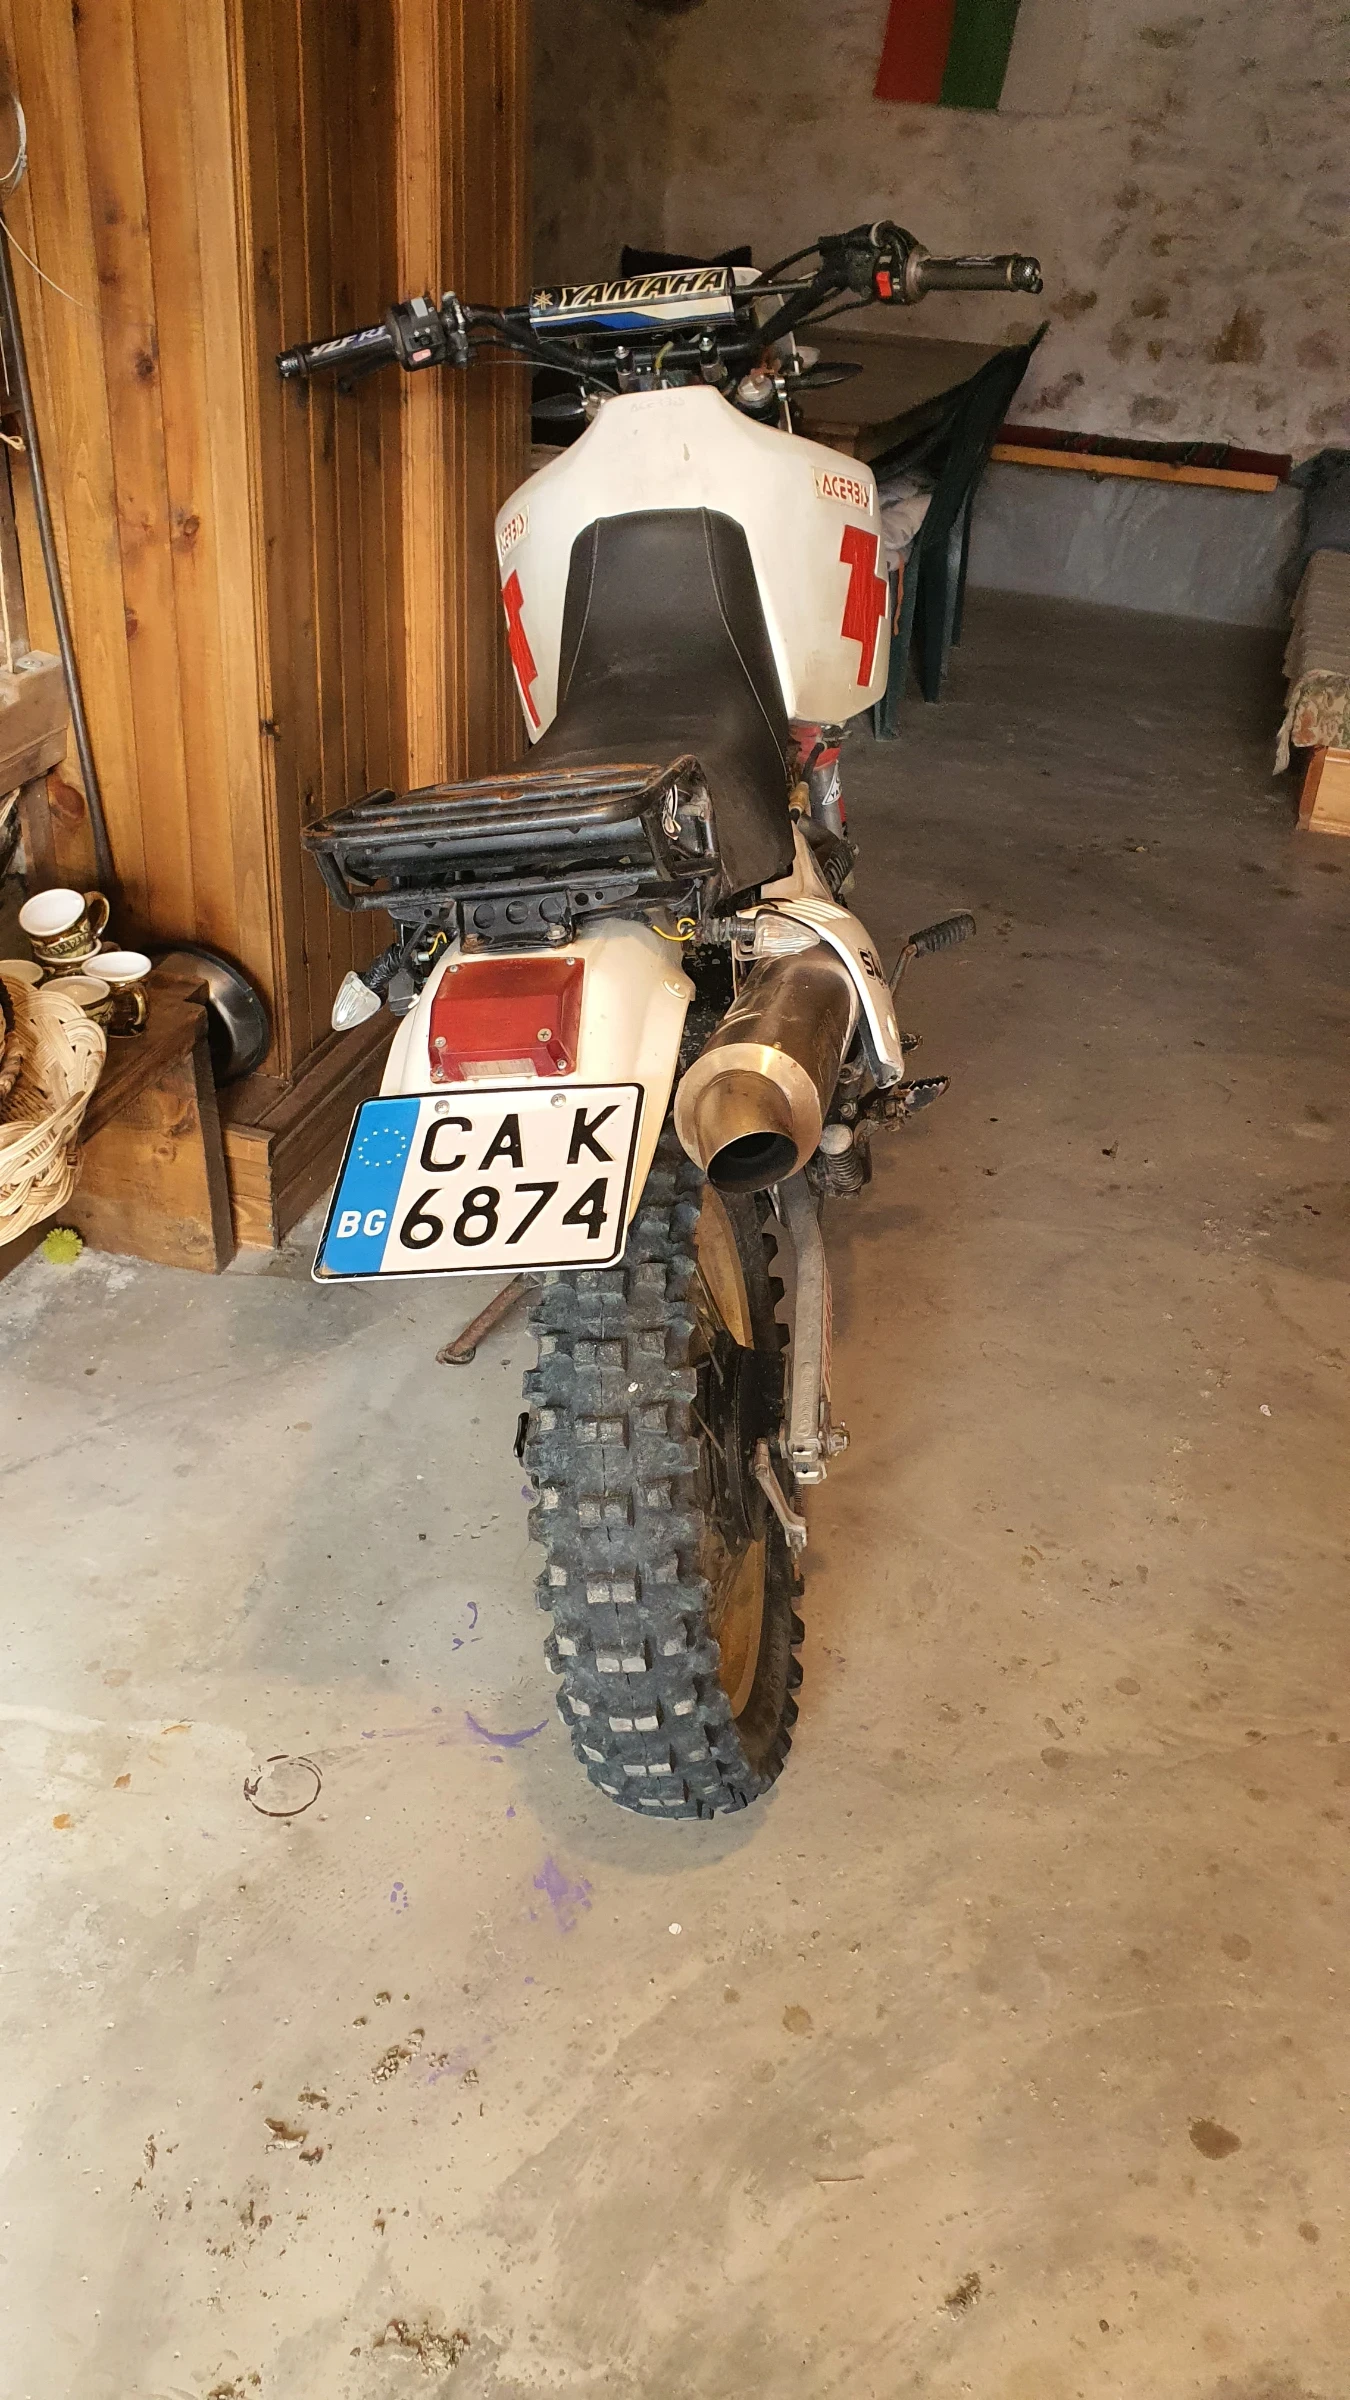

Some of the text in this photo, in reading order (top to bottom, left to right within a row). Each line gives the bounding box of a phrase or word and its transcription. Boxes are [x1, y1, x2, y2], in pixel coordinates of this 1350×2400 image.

[558, 269, 728, 310] YAMAHA
[419, 1104, 621, 1173] CA K
[336, 1208, 387, 1239] BG
[399, 1177, 609, 1250] 6874
